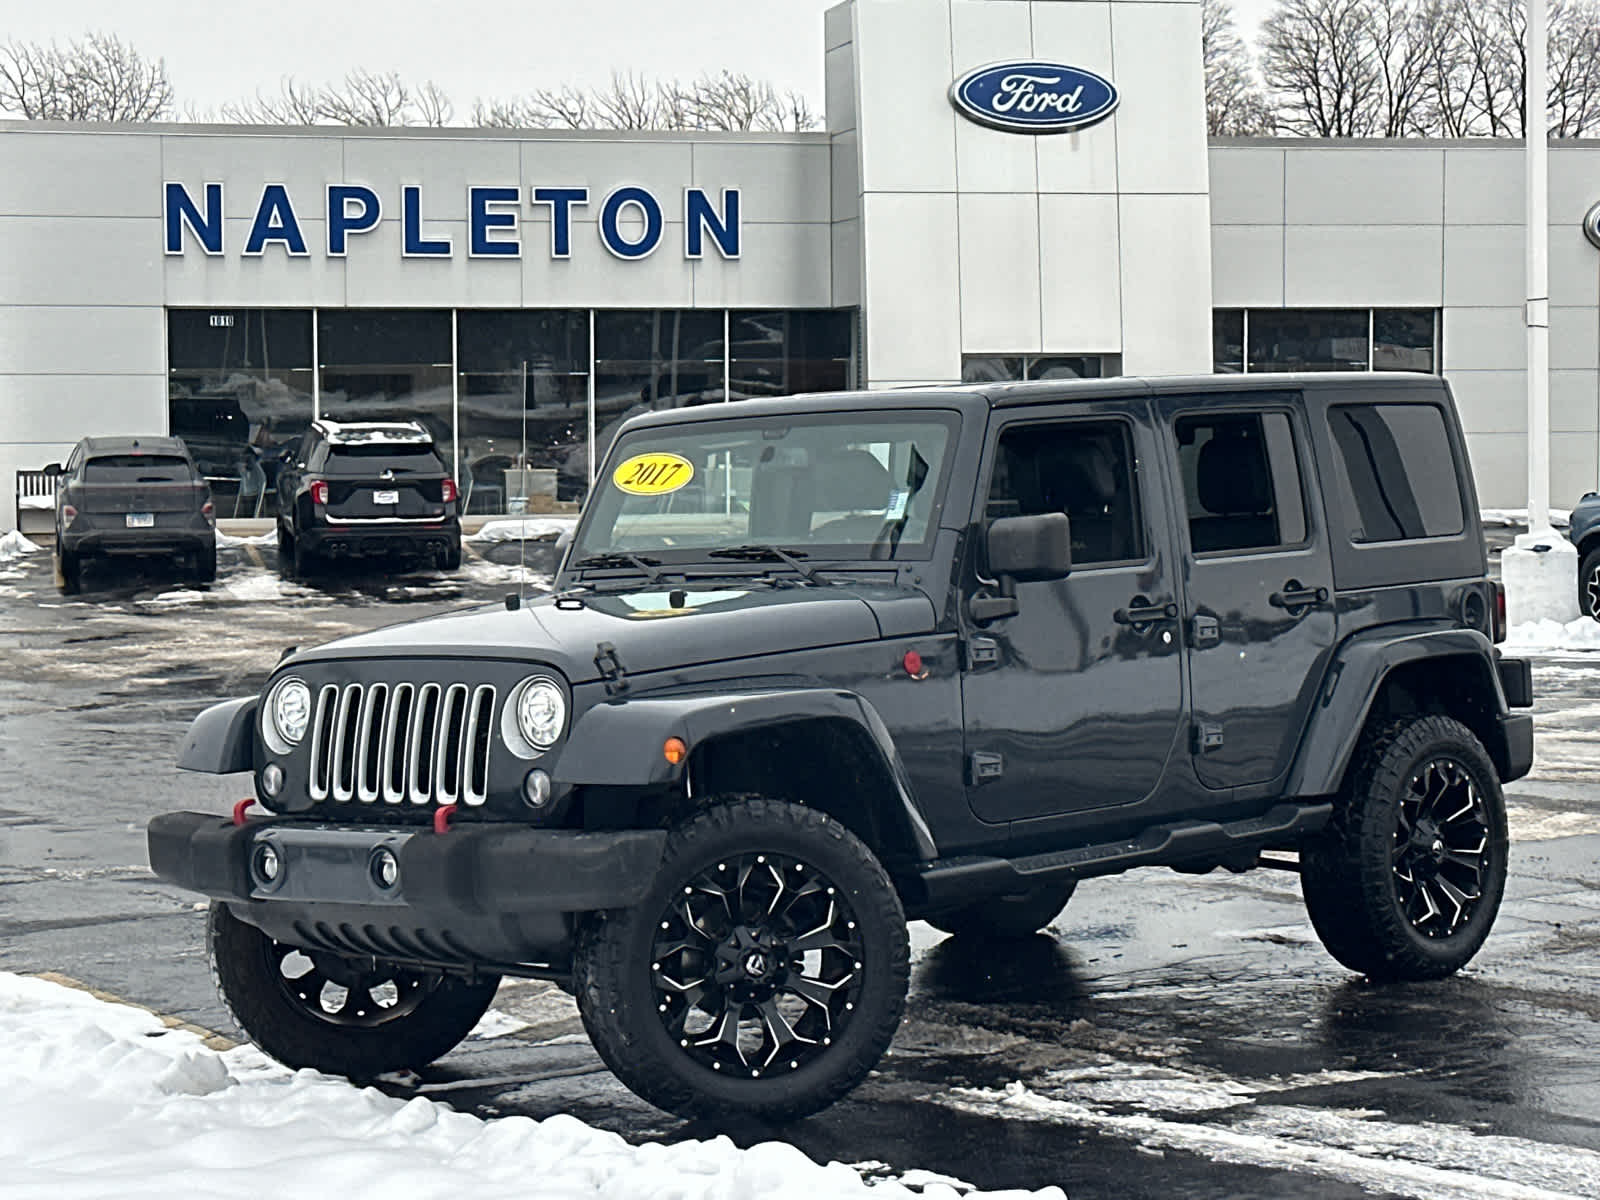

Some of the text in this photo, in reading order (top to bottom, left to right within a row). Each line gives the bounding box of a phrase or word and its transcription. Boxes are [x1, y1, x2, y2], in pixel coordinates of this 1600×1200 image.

[992, 74, 1084, 112] Ford
[162, 180, 742, 260] NAPLETON
[622, 462, 684, 486] 2017
